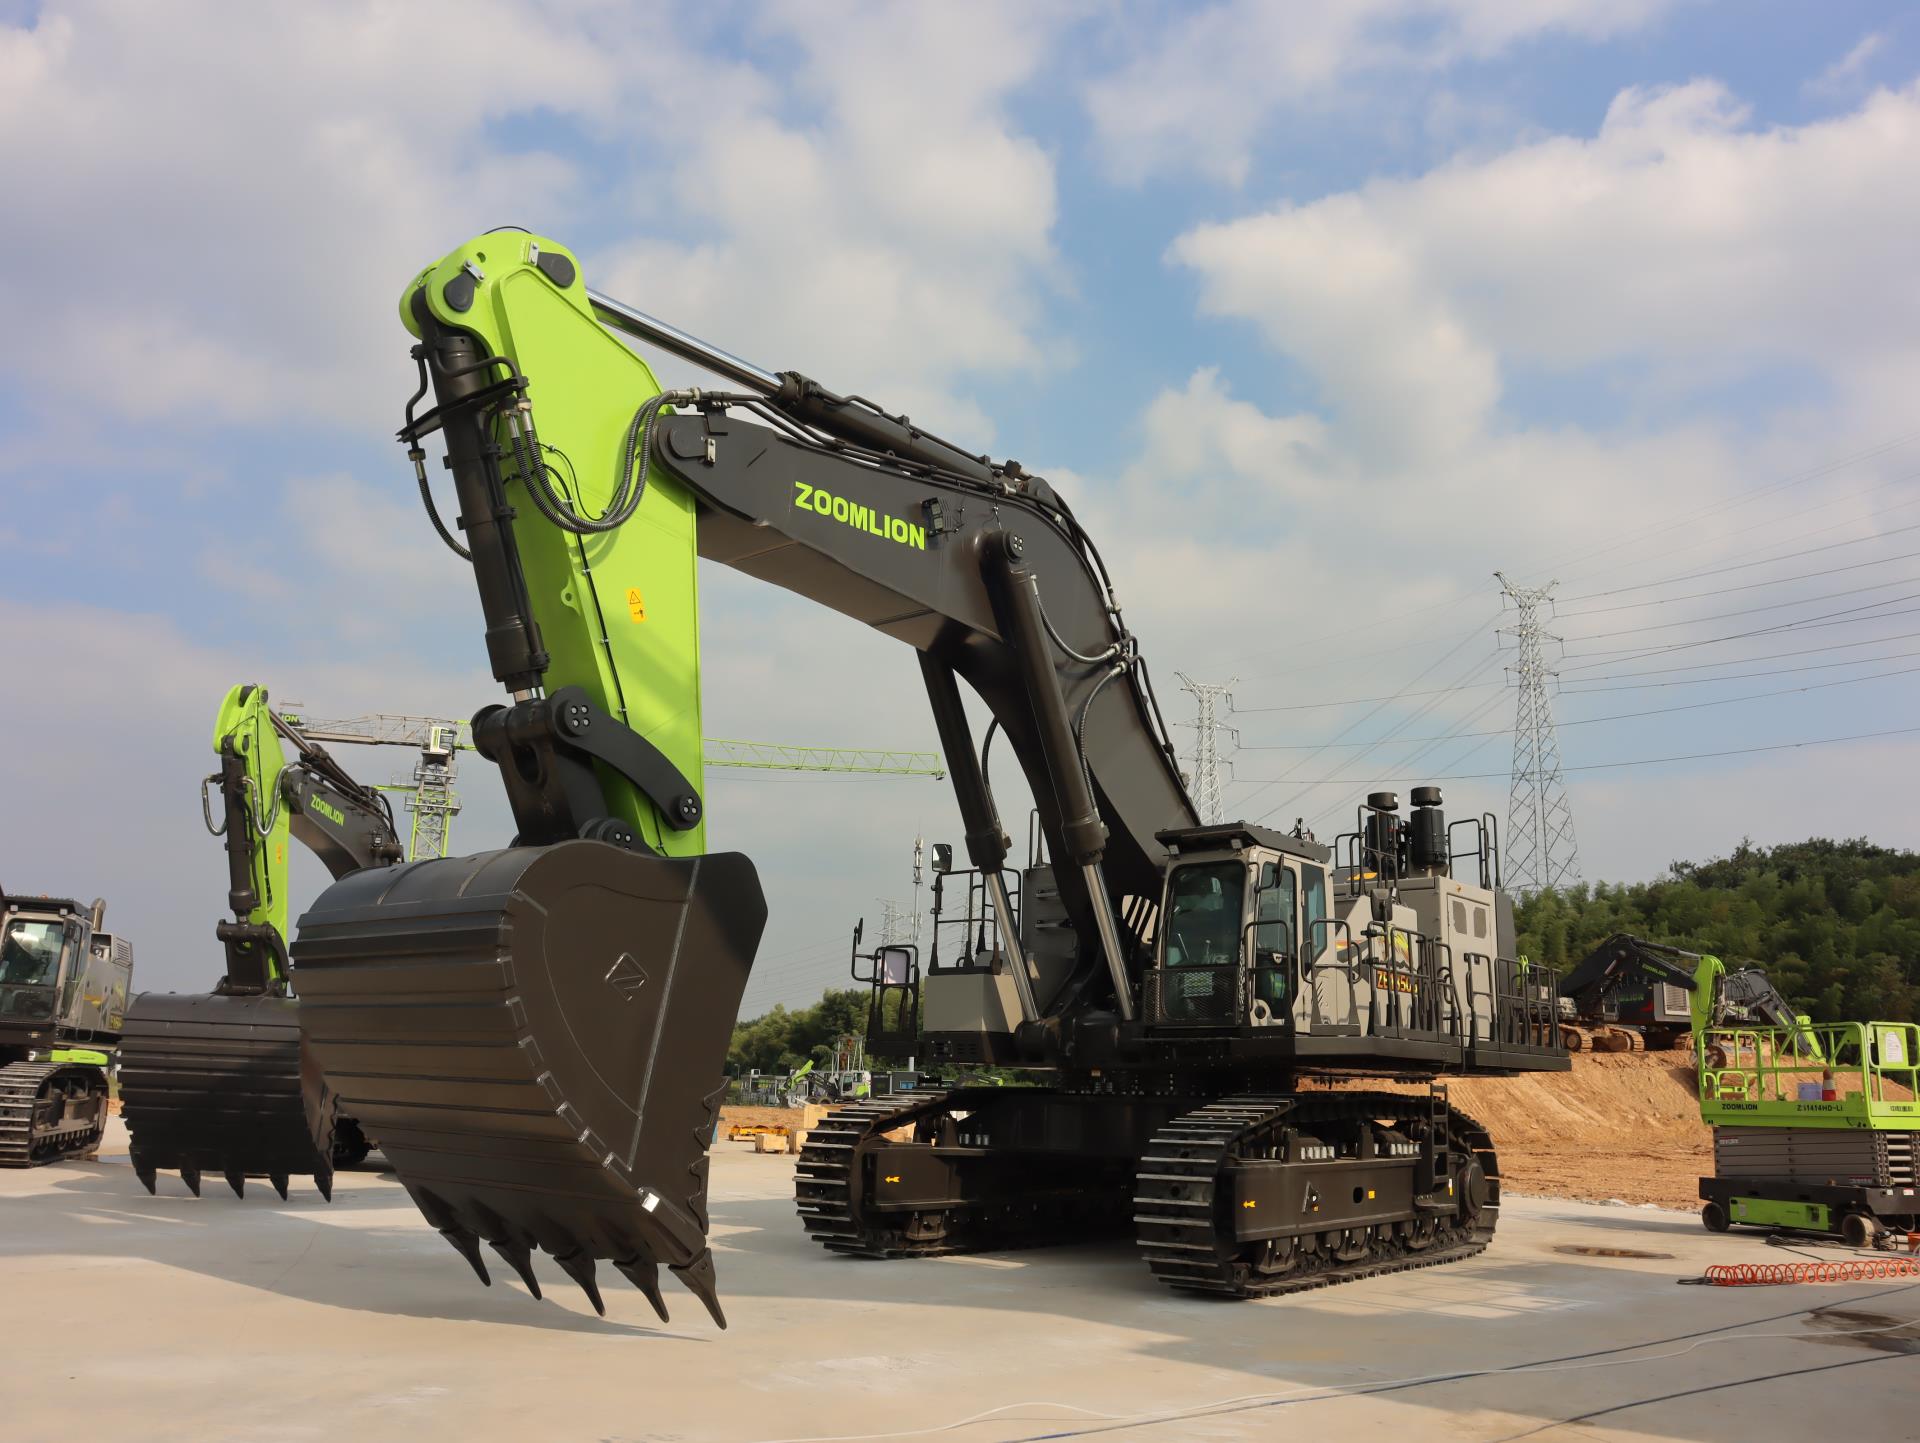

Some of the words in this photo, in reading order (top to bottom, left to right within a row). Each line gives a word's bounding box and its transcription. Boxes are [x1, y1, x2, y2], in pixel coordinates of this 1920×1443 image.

[795, 481, 925, 551] ZOOMLION
[311, 793, 345, 827] ZOOMLION
[1721, 1103, 1758, 1111] ZOOMLION
